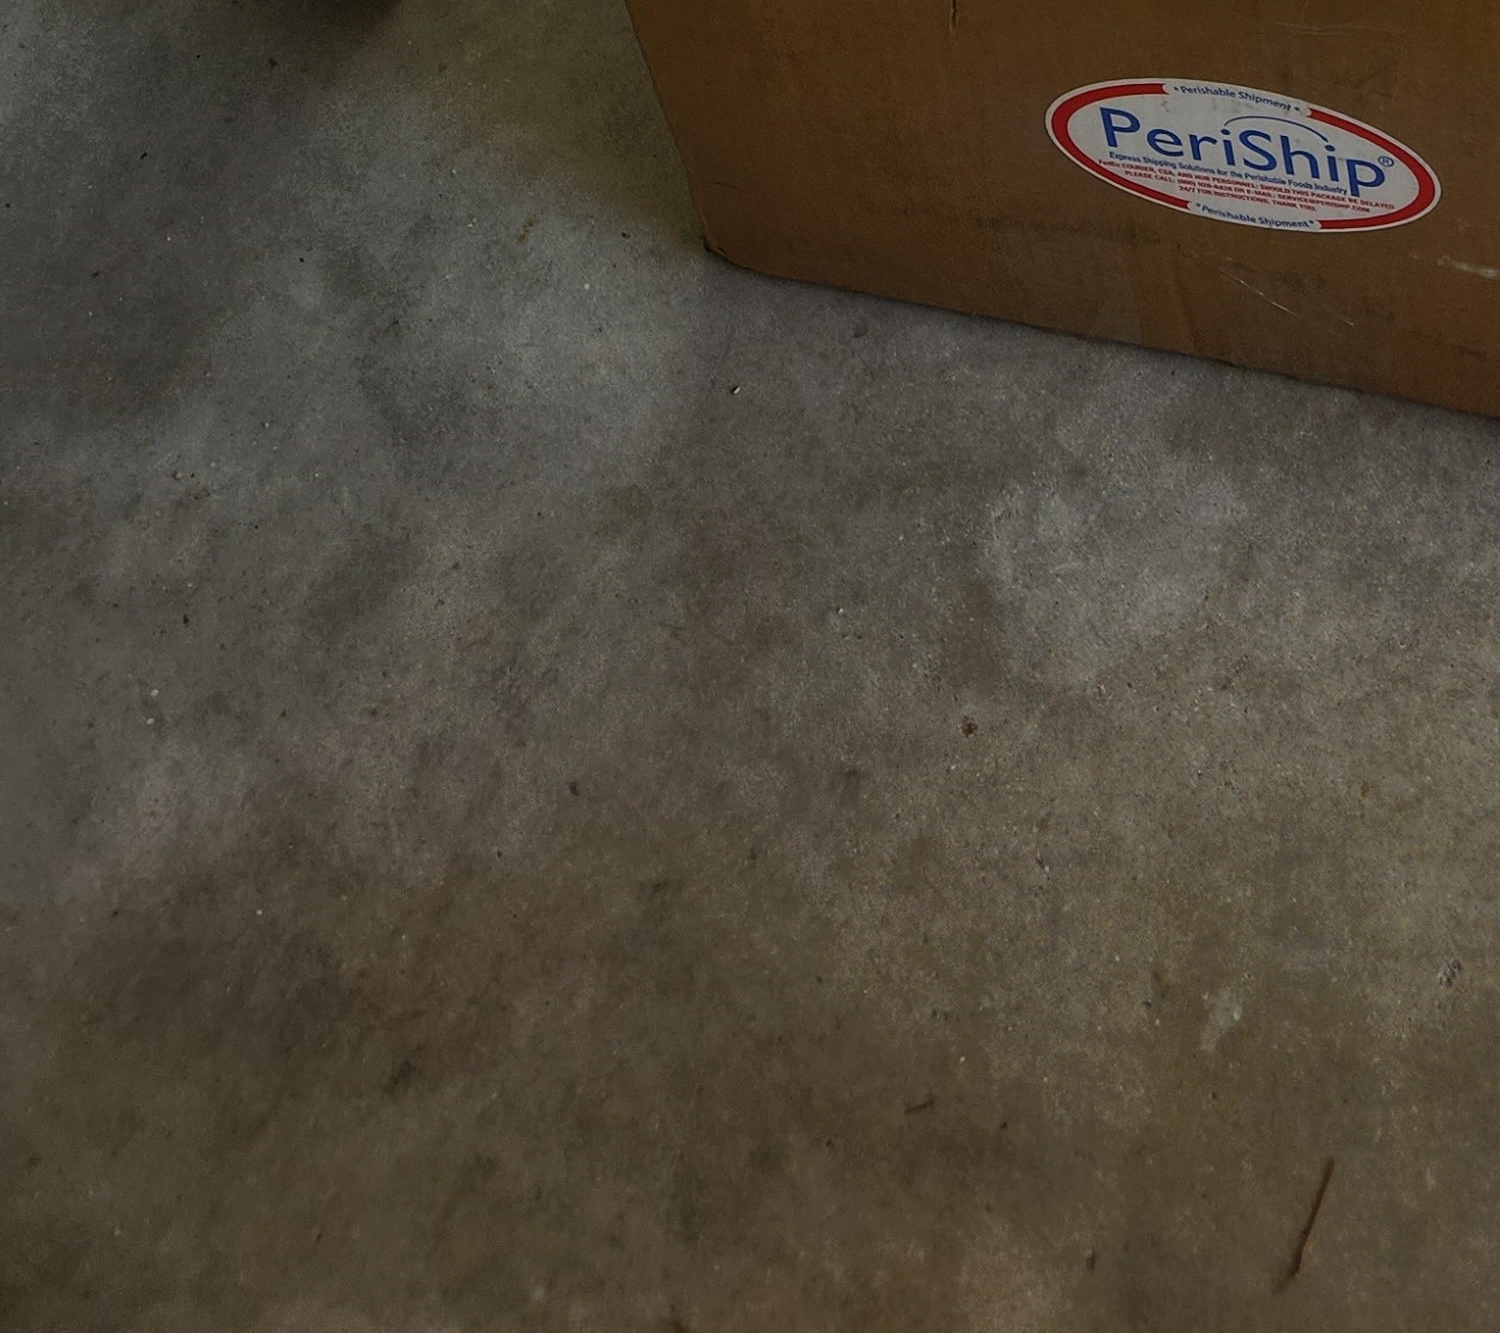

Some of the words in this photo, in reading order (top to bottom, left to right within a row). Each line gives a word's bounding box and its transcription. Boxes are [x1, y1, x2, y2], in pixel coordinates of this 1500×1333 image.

[1180, 86, 1236, 97] Perishable
[1237, 90, 1292, 112] Shipment
[1108, 150, 1141, 163] Express
[1141, 155, 1177, 170] Shipping
[1178, 161, 1215, 174] Solutions
[1243, 171, 1287, 185] Perishable
[1287, 178, 1313, 189] Foods
[1313, 182, 1348, 196] Industry
